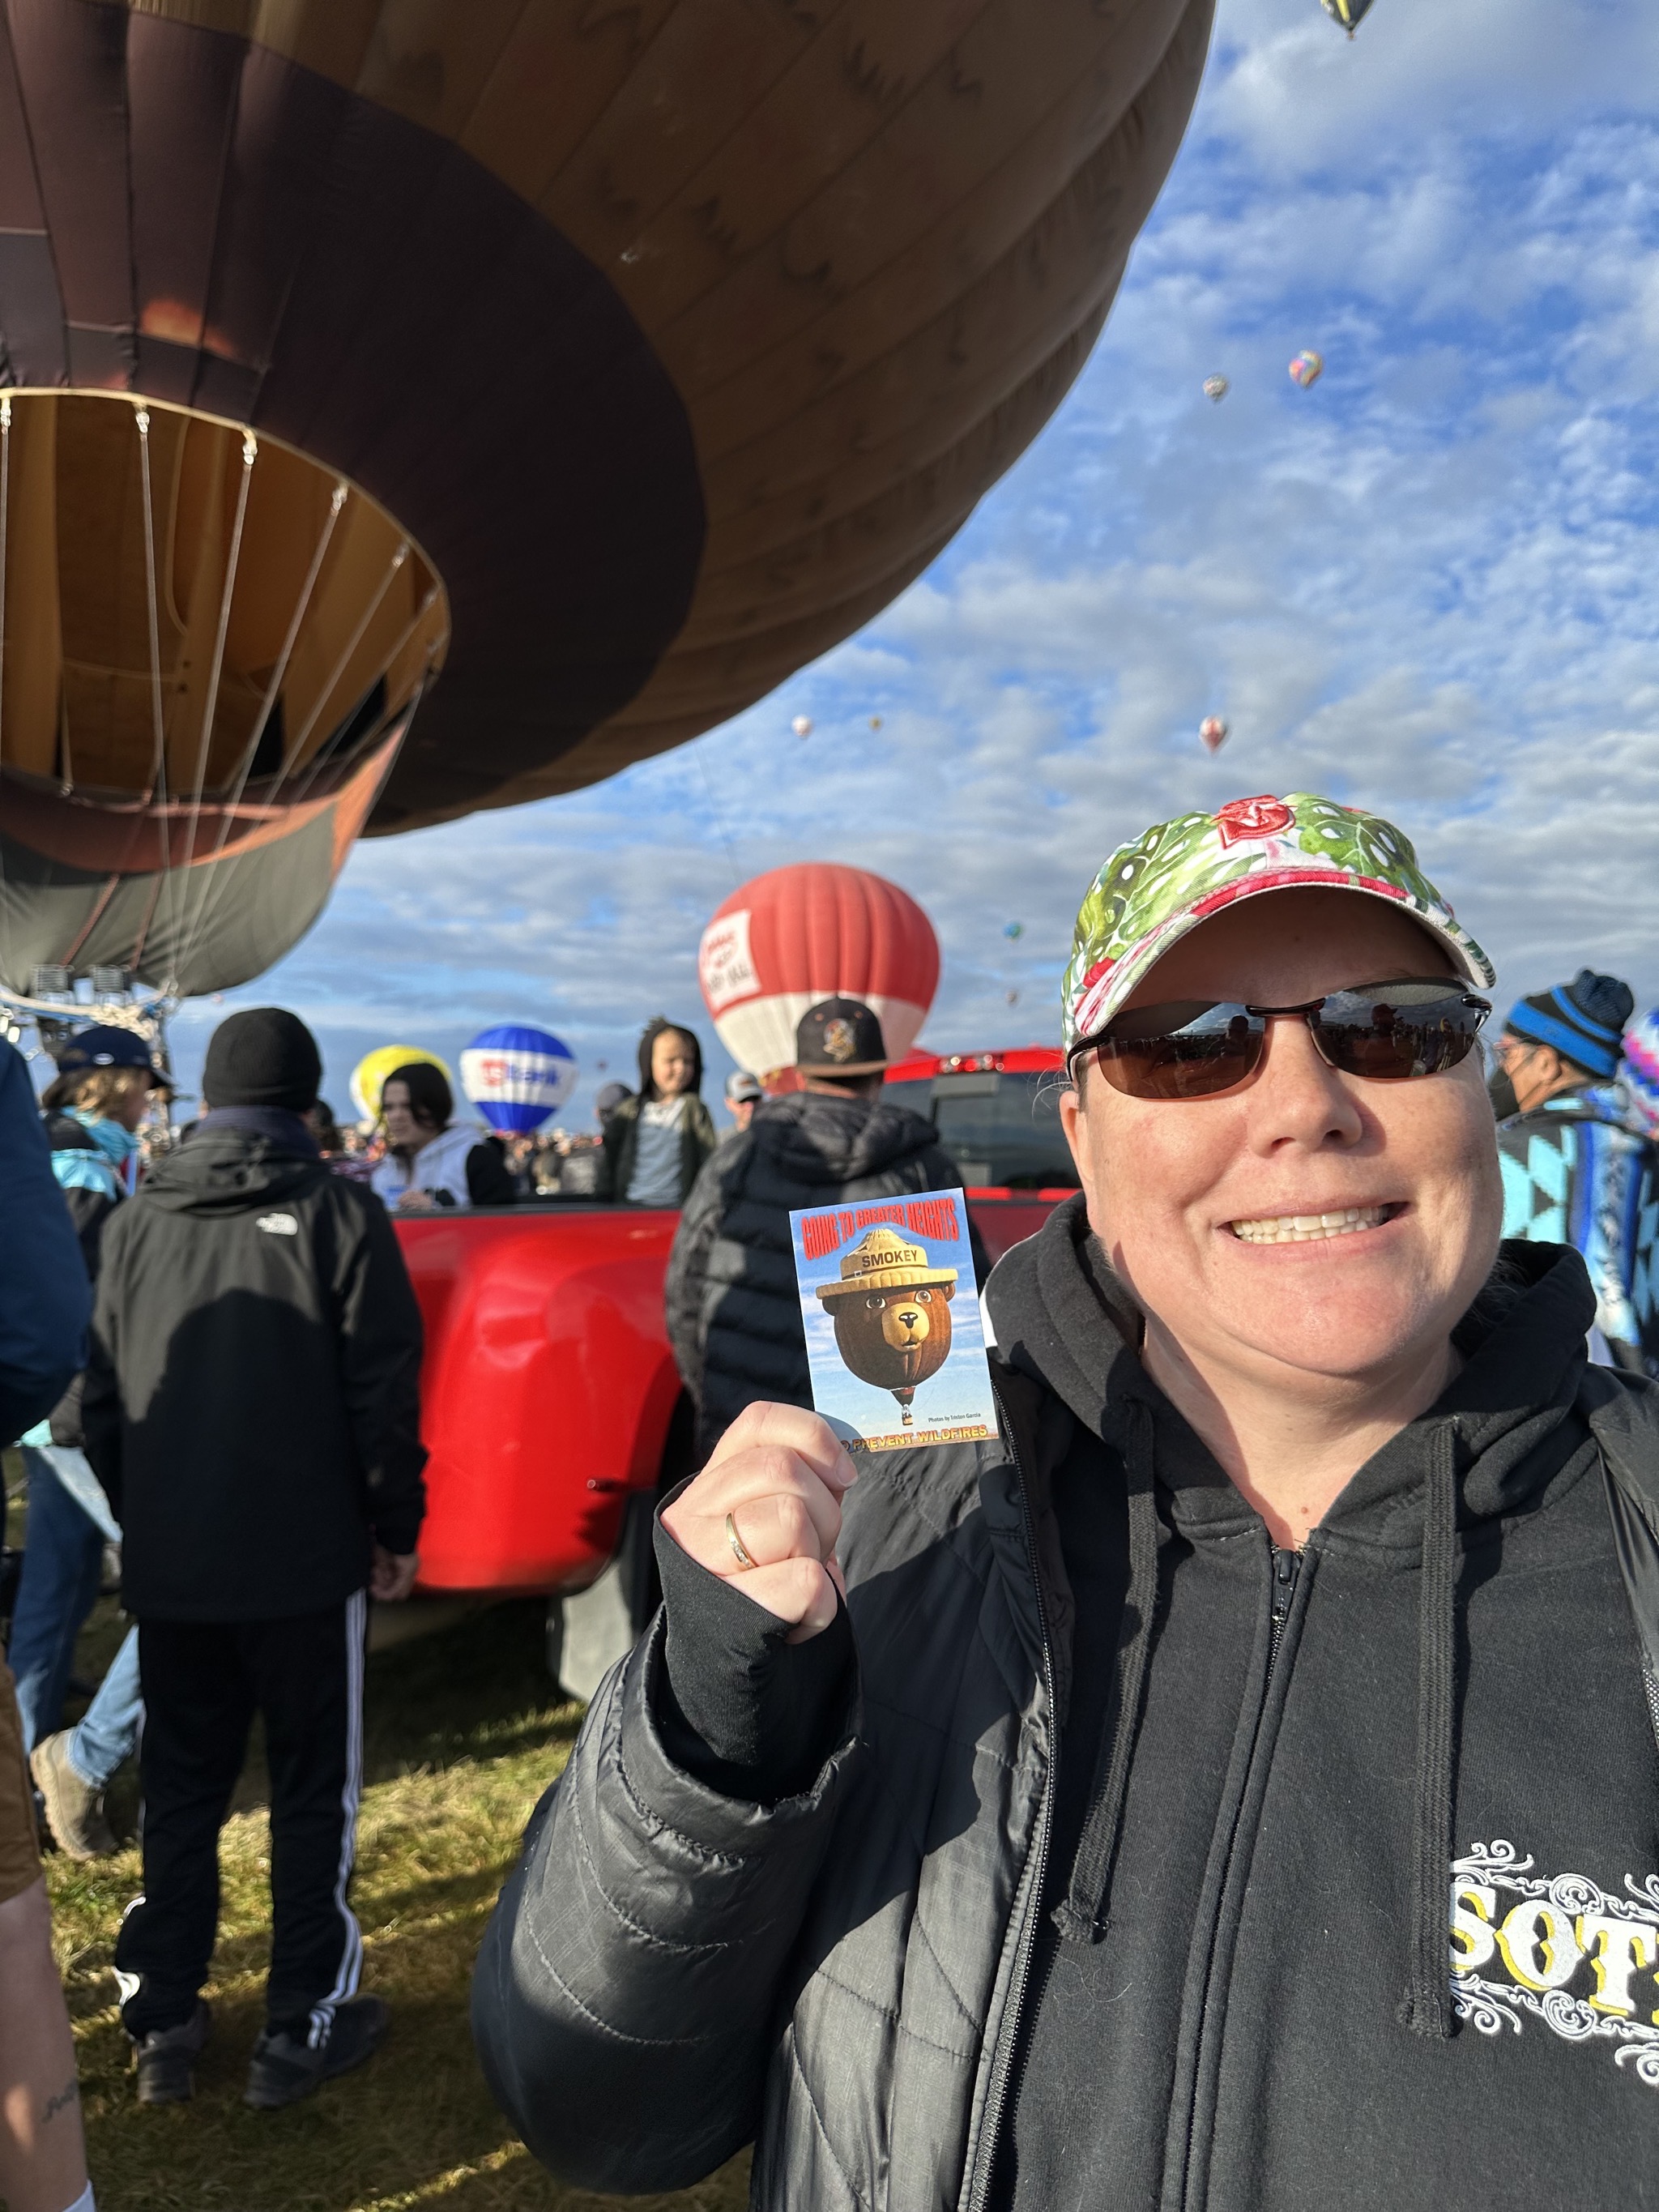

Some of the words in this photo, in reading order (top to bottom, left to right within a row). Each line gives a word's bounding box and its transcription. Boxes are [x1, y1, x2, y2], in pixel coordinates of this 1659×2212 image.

[801, 1216, 840, 1261] GOING
[838, 1211, 855, 1243] TO
[855, 1205, 906, 1229] GREATER
[906, 1197, 959, 1241] HEIGHTS
[862, 1249, 917, 1267] SMOKEY
[852, 1433, 914, 1450] PREVENT
[916, 1424, 987, 1442] WILDFIRES
[1449, 1881, 1659, 2026] SOT
